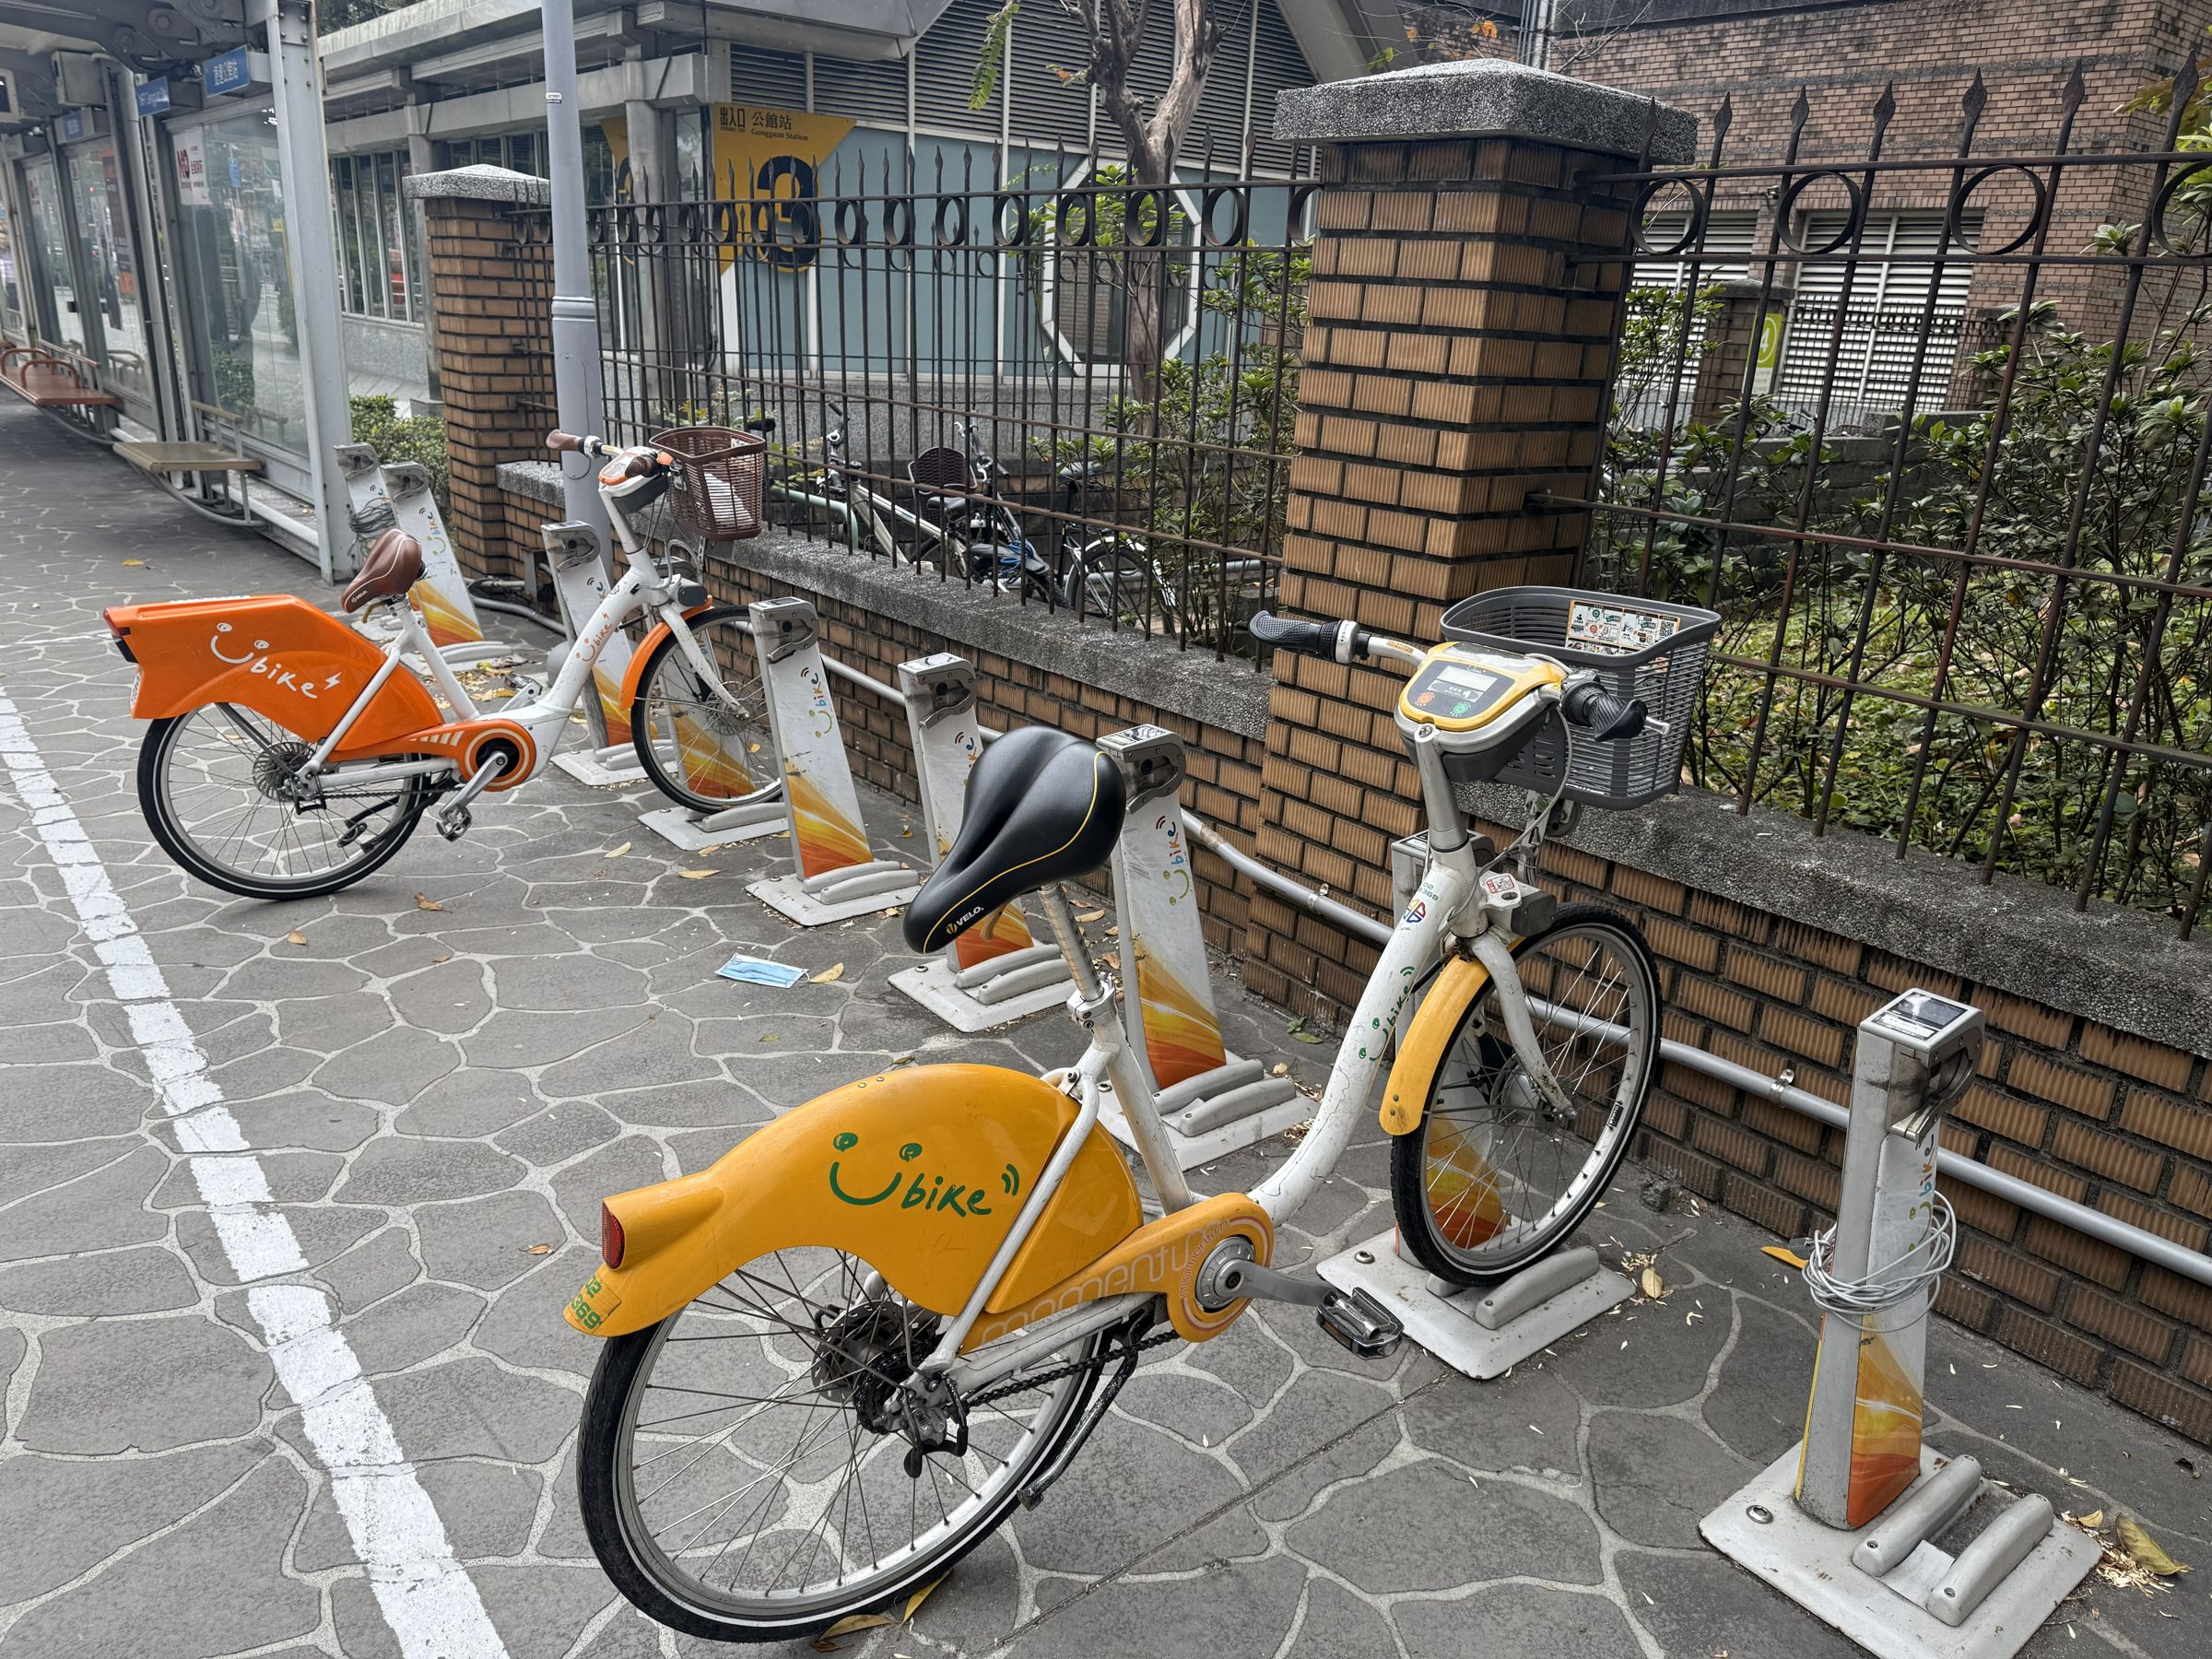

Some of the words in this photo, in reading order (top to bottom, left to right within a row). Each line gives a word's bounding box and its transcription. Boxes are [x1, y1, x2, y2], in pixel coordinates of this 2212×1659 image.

[720, 106, 746, 128] 出入口
[751, 111, 793, 130] 公館站
[751, 127, 785, 139] Gongguan
[785, 133, 808, 141] Station
[757, 156, 822, 272] 3
[1759, 327, 1770, 353] 4
[956, 906, 982, 926] VELO
[1179, 1219, 1230, 1298] momentum
